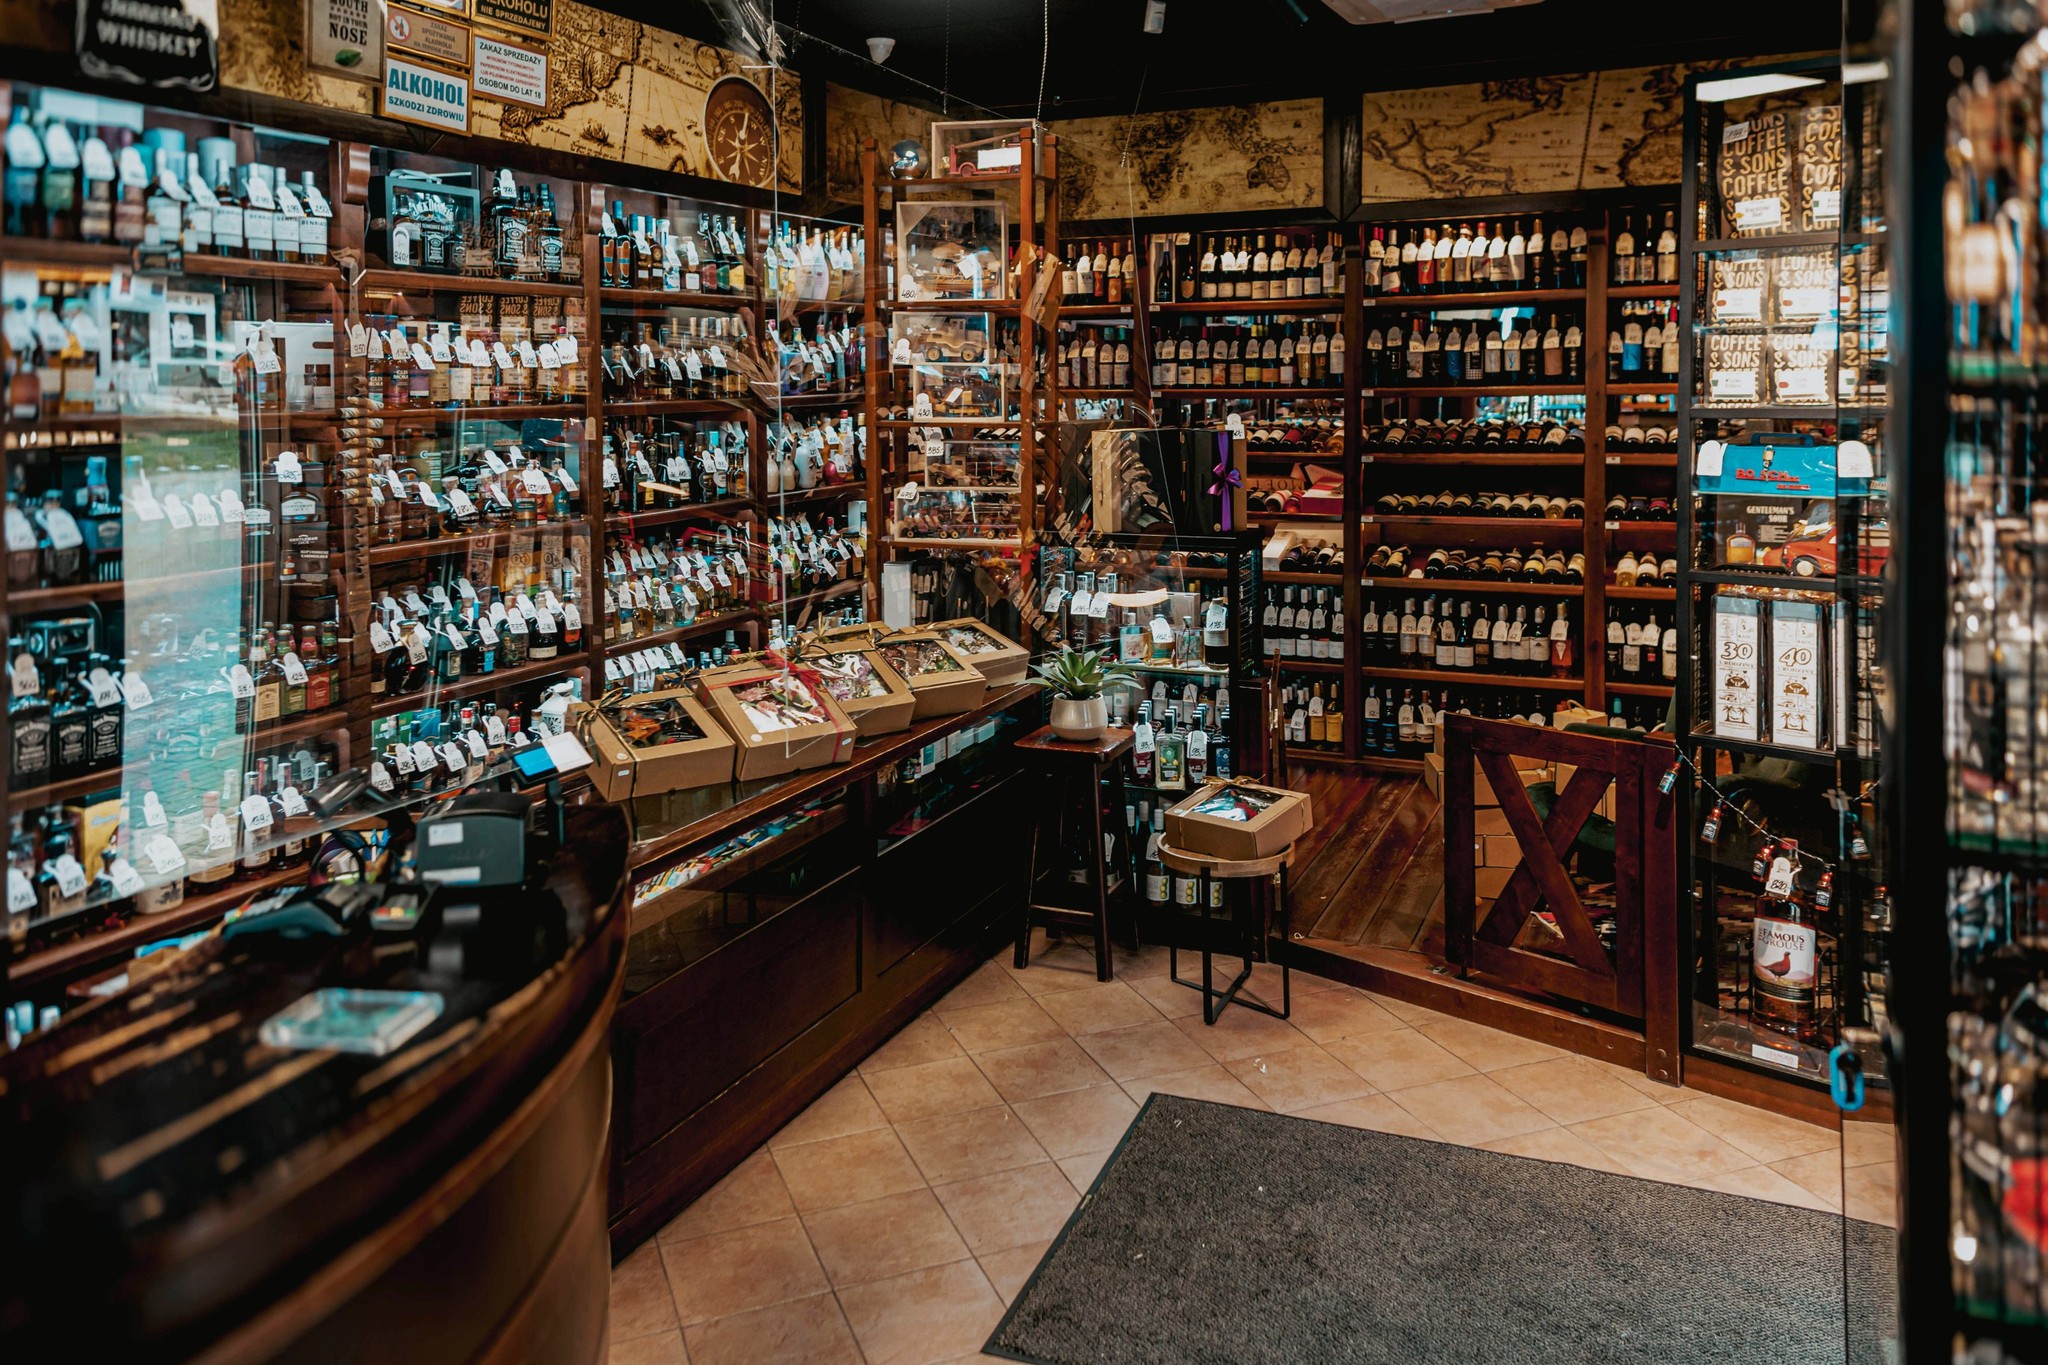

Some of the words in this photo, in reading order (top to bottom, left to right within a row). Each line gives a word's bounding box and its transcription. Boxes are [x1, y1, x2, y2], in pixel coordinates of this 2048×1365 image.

[481, 5, 494, 15] NIE
[495, 8, 546, 30] SPRZEDAJEMY
[97, 19, 201, 58] WHISKEY
[329, 22, 368, 46] NOSE
[480, 42, 502, 55] ZAKAZ
[503, 48, 542, 66] SPRZEDAŻY
[388, 67, 465, 107] ALKOHOL
[479, 77, 508, 91] OSOBOM
[510, 84, 520, 94] DO
[521, 87, 533, 97] LAT
[534, 91, 541, 99] 18
[388, 95, 425, 112] SZKODZI
[426, 105, 464, 122] ZDROWIU
[1722, 126, 1786, 157] COFFEE
[1740, 147, 1786, 175] SONS
[1722, 167, 1788, 198] COFFEE
[1730, 270, 1764, 288] SONS
[1793, 269, 1833, 286] SONS
[1711, 334, 1762, 351] COFFEE
[1722, 352, 1760, 368] SONS
[1788, 350, 1828, 368] SONS
[1746, 506, 1795, 515] GENTLEMAN'S
[1769, 514, 1788, 523] SOUR
[1720, 641, 1753, 660] 30
[1779, 647, 1812, 667] 40
[1763, 928, 1805, 944] FAMOUS
[1763, 937, 1805, 951] GROUSE
